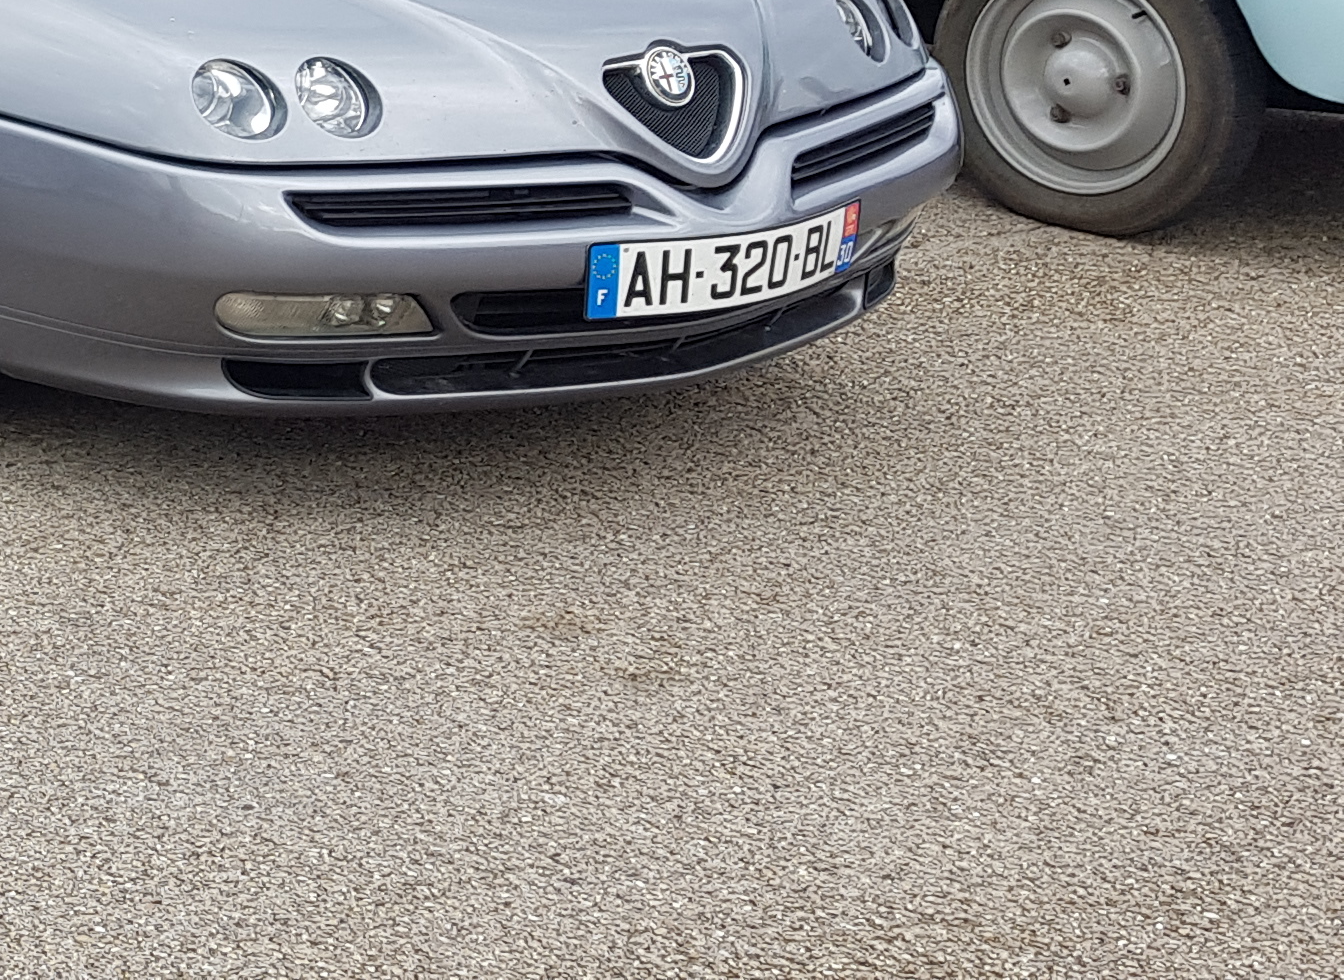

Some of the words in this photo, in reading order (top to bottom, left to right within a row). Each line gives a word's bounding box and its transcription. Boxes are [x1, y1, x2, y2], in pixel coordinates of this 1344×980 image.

[624, 220, 835, 307] AH-320-BL
[836, 241, 854, 266] 30
[596, 289, 609, 306] F
